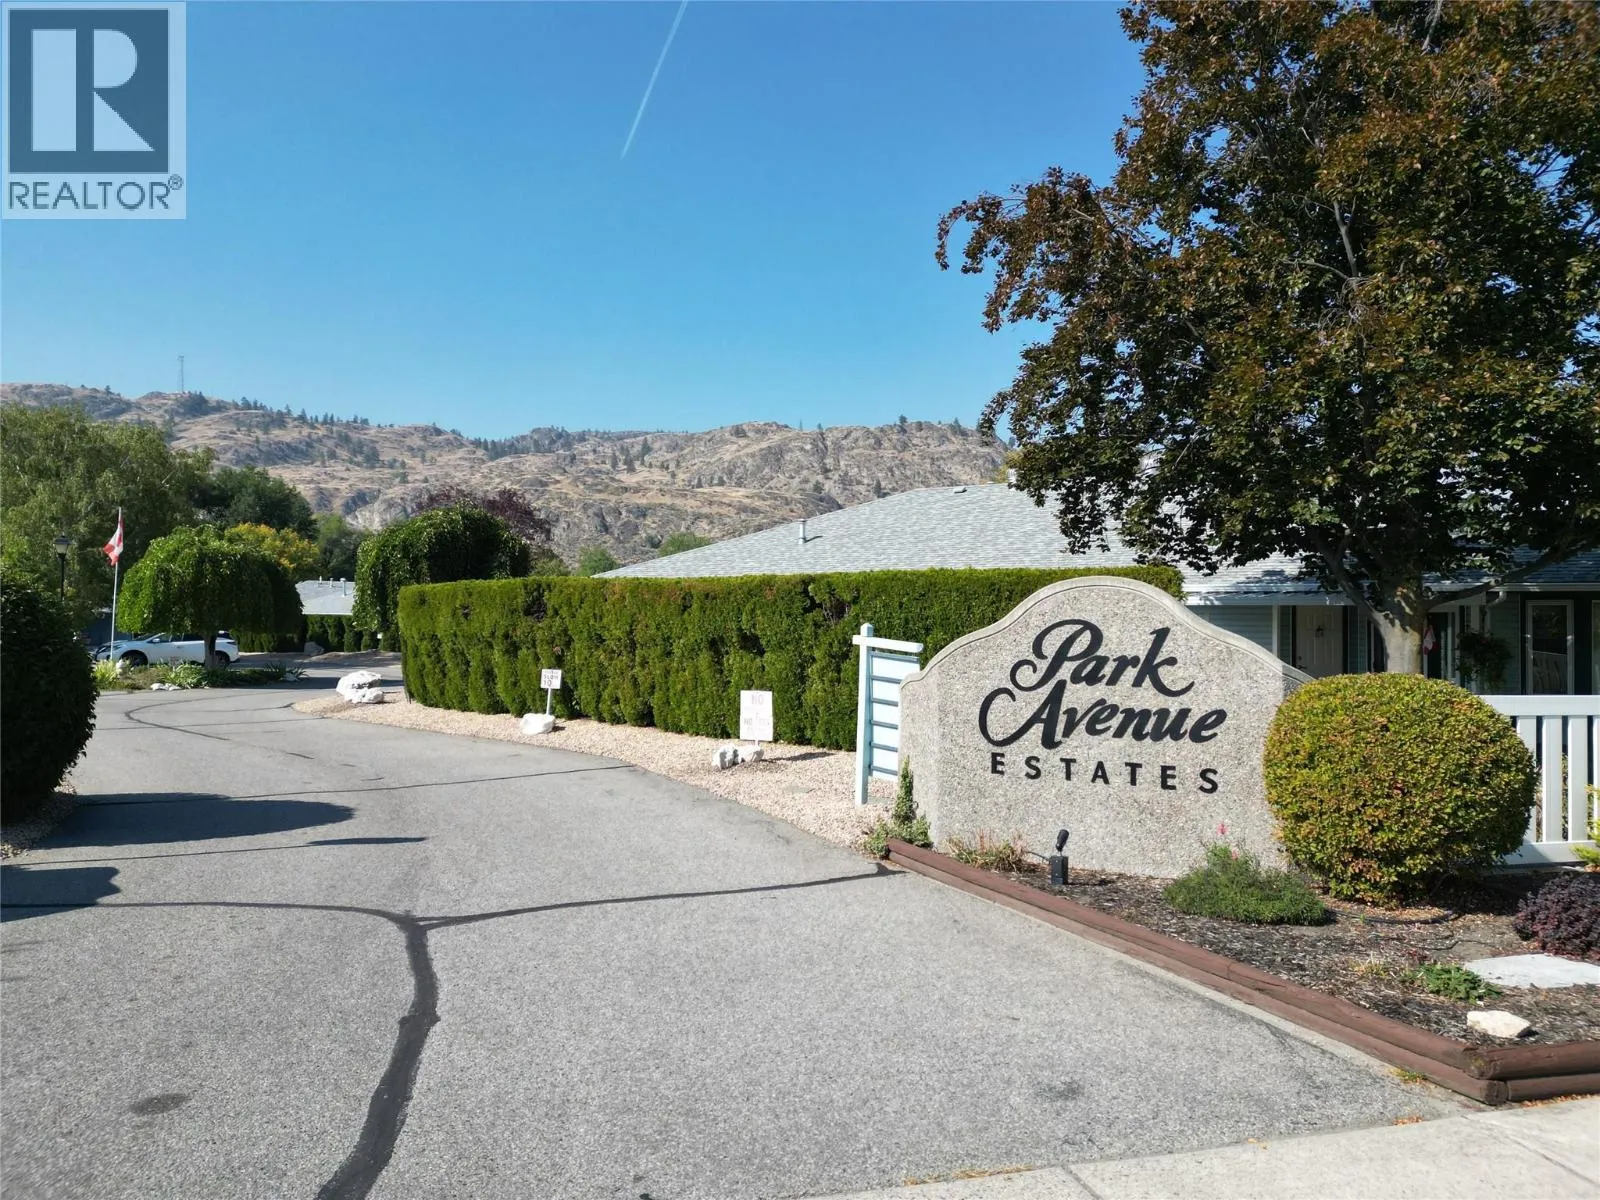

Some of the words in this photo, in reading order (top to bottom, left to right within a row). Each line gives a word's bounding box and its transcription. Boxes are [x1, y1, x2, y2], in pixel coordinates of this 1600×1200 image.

[1009, 618, 1195, 698] Park
[751, 694, 764, 705] NO
[978, 679, 1228, 750] Avenue
[990, 752, 1219, 794] ESTATES
